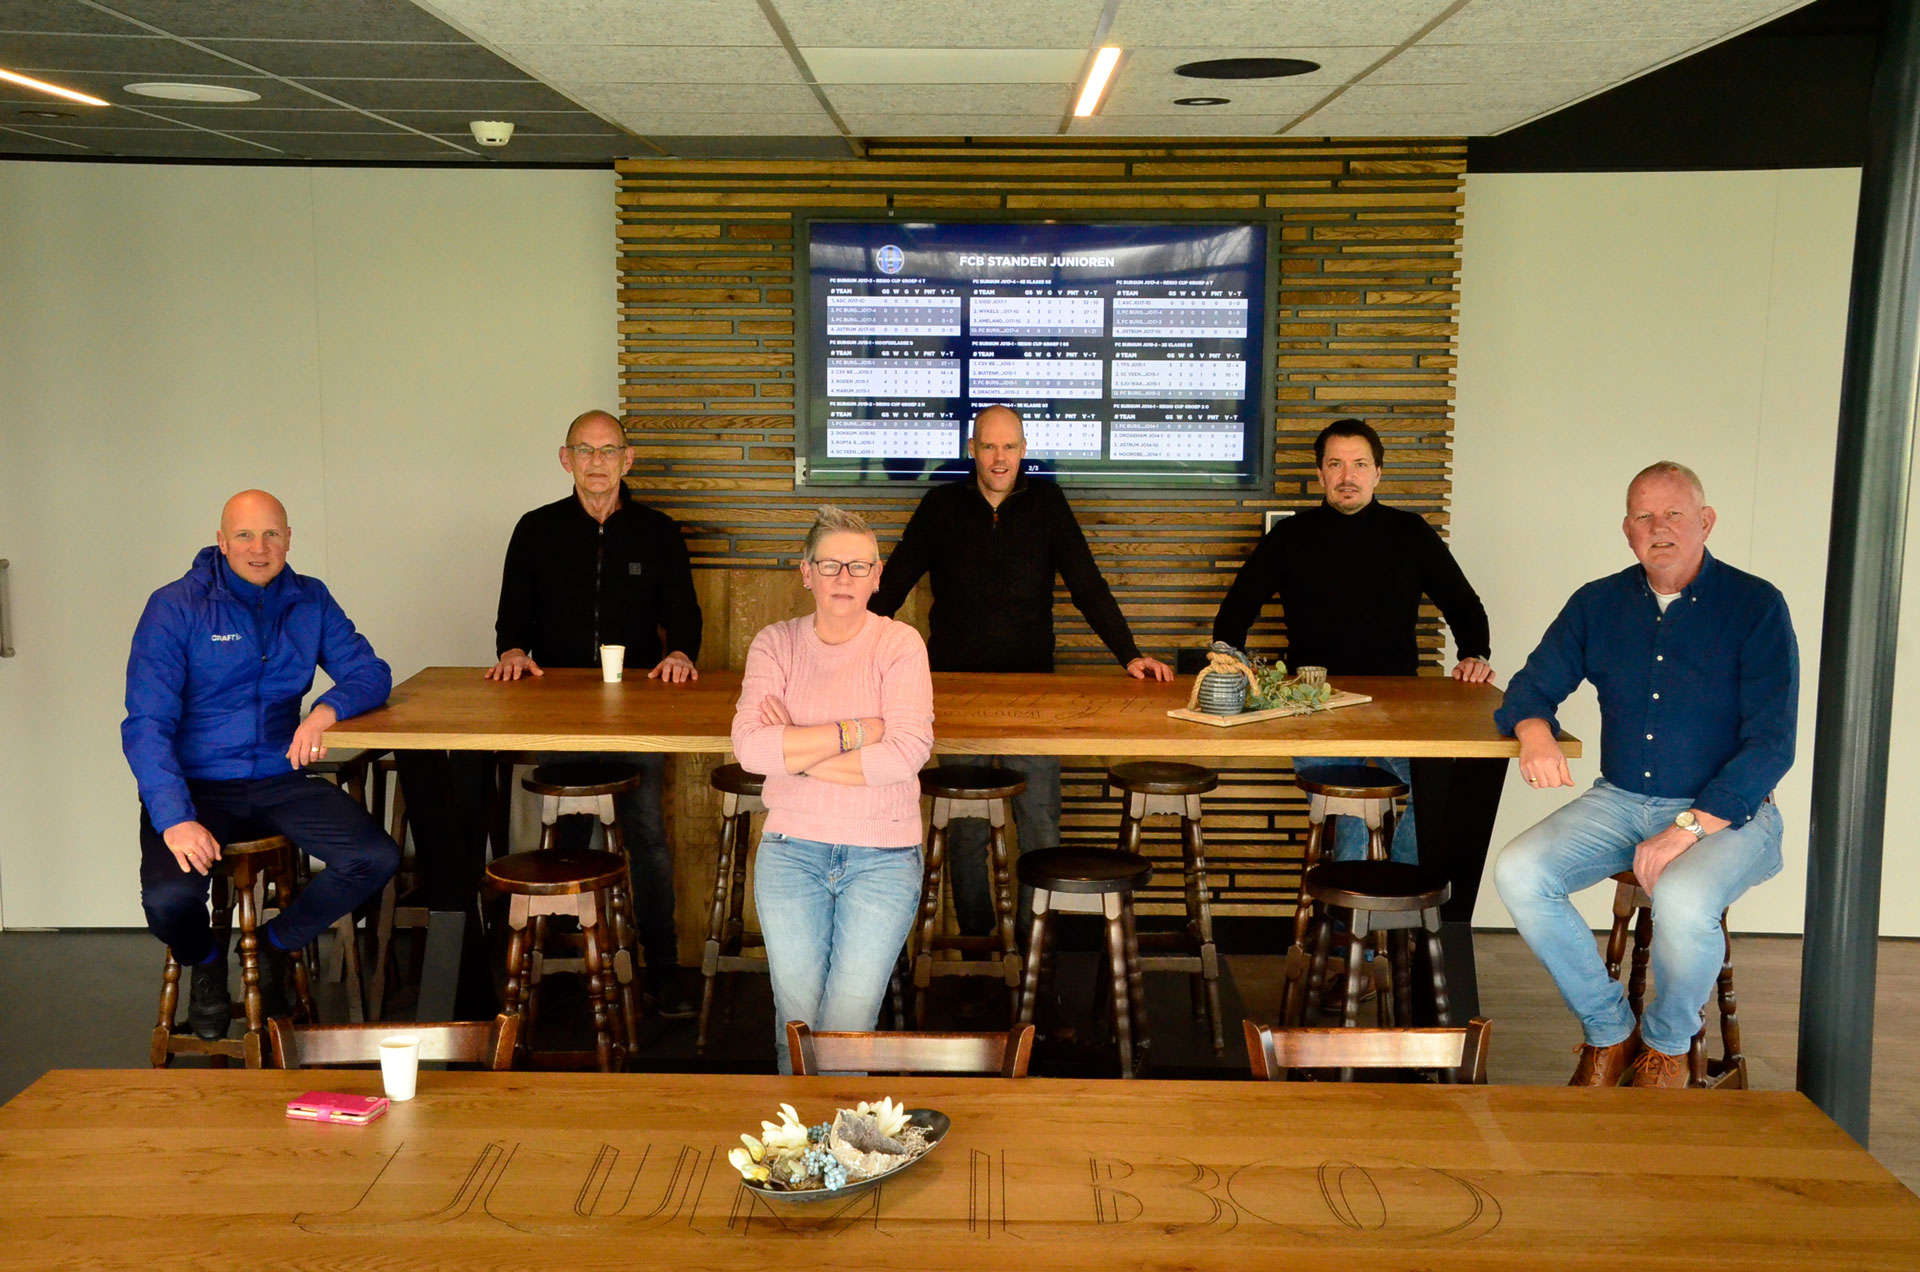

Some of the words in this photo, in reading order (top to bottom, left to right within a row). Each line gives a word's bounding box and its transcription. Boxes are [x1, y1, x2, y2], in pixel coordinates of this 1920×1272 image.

[959, 256, 985, 267] FCB
[987, 256, 1047, 267] STANDEN
[1049, 256, 1115, 268] JUNIOREN
[211, 634, 236, 642] CRAFT
